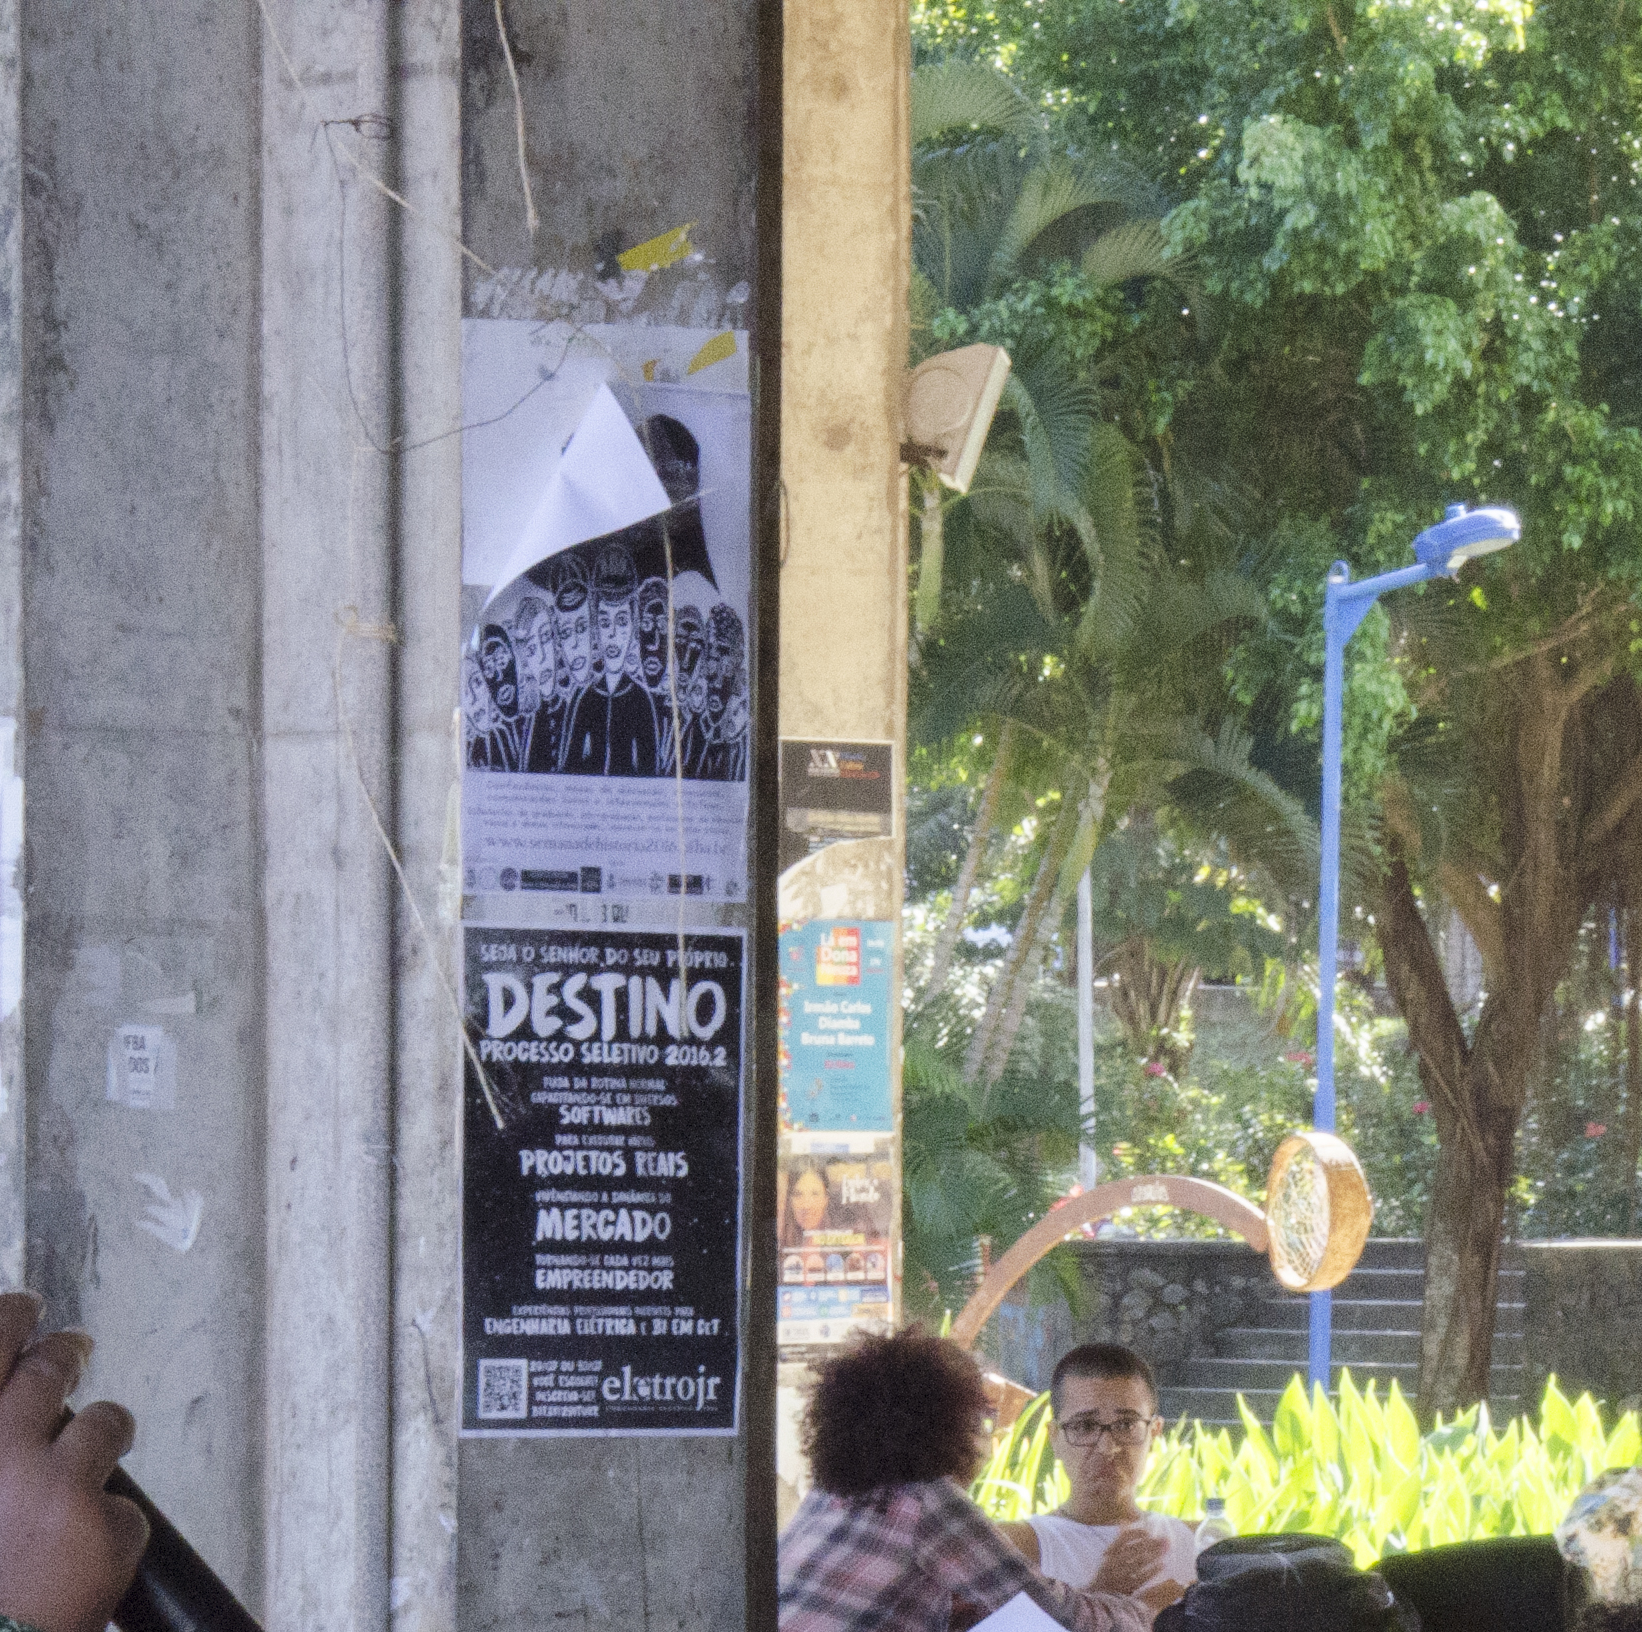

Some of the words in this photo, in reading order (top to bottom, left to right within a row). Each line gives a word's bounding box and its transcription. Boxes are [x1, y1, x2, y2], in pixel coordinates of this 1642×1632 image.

[480, 943, 516, 963] SEJA
[521, 945, 535, 963] O
[539, 945, 599, 965] SENHOR
[604, 947, 629, 966] DO
[633, 947, 661, 967] SEU
[481, 971, 727, 1042] DESTINO
[479, 1040, 574, 1065] PROCESSO
[580, 1041, 660, 1066] SELETIVO
[664, 1045, 727, 1068] 2016.2
[559, 1104, 652, 1127] SOFTWARES
[518, 1149, 627, 1178] PROJETOS
[634, 1150, 689, 1178] REAIS
[535, 1207, 672, 1243] MERCADO
[535, 1269, 674, 1291] EMPREENDEDOR
